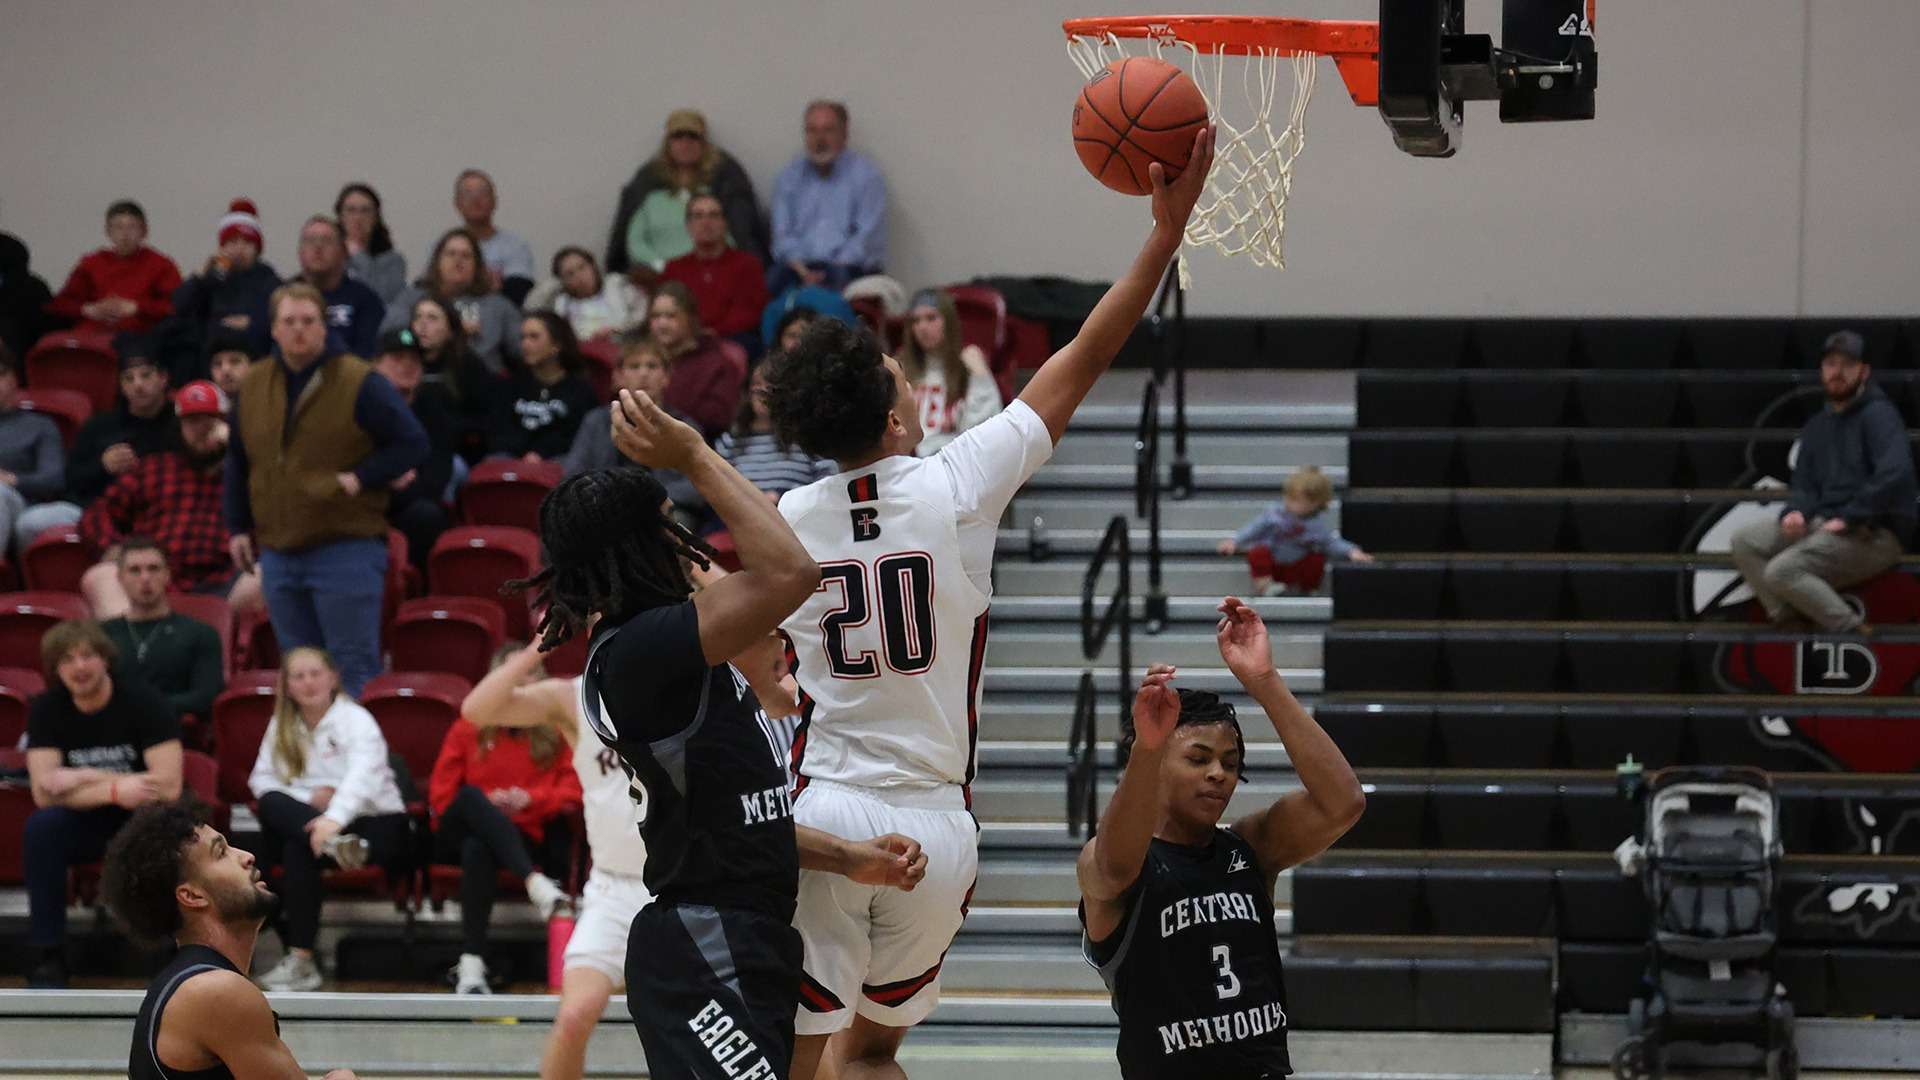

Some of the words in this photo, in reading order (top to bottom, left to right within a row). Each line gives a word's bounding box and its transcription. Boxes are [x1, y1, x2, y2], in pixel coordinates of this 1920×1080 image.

[816, 551, 936, 680] 20
[1160, 892, 1261, 938] CENTRAL
[1212, 945, 1241, 999] 3
